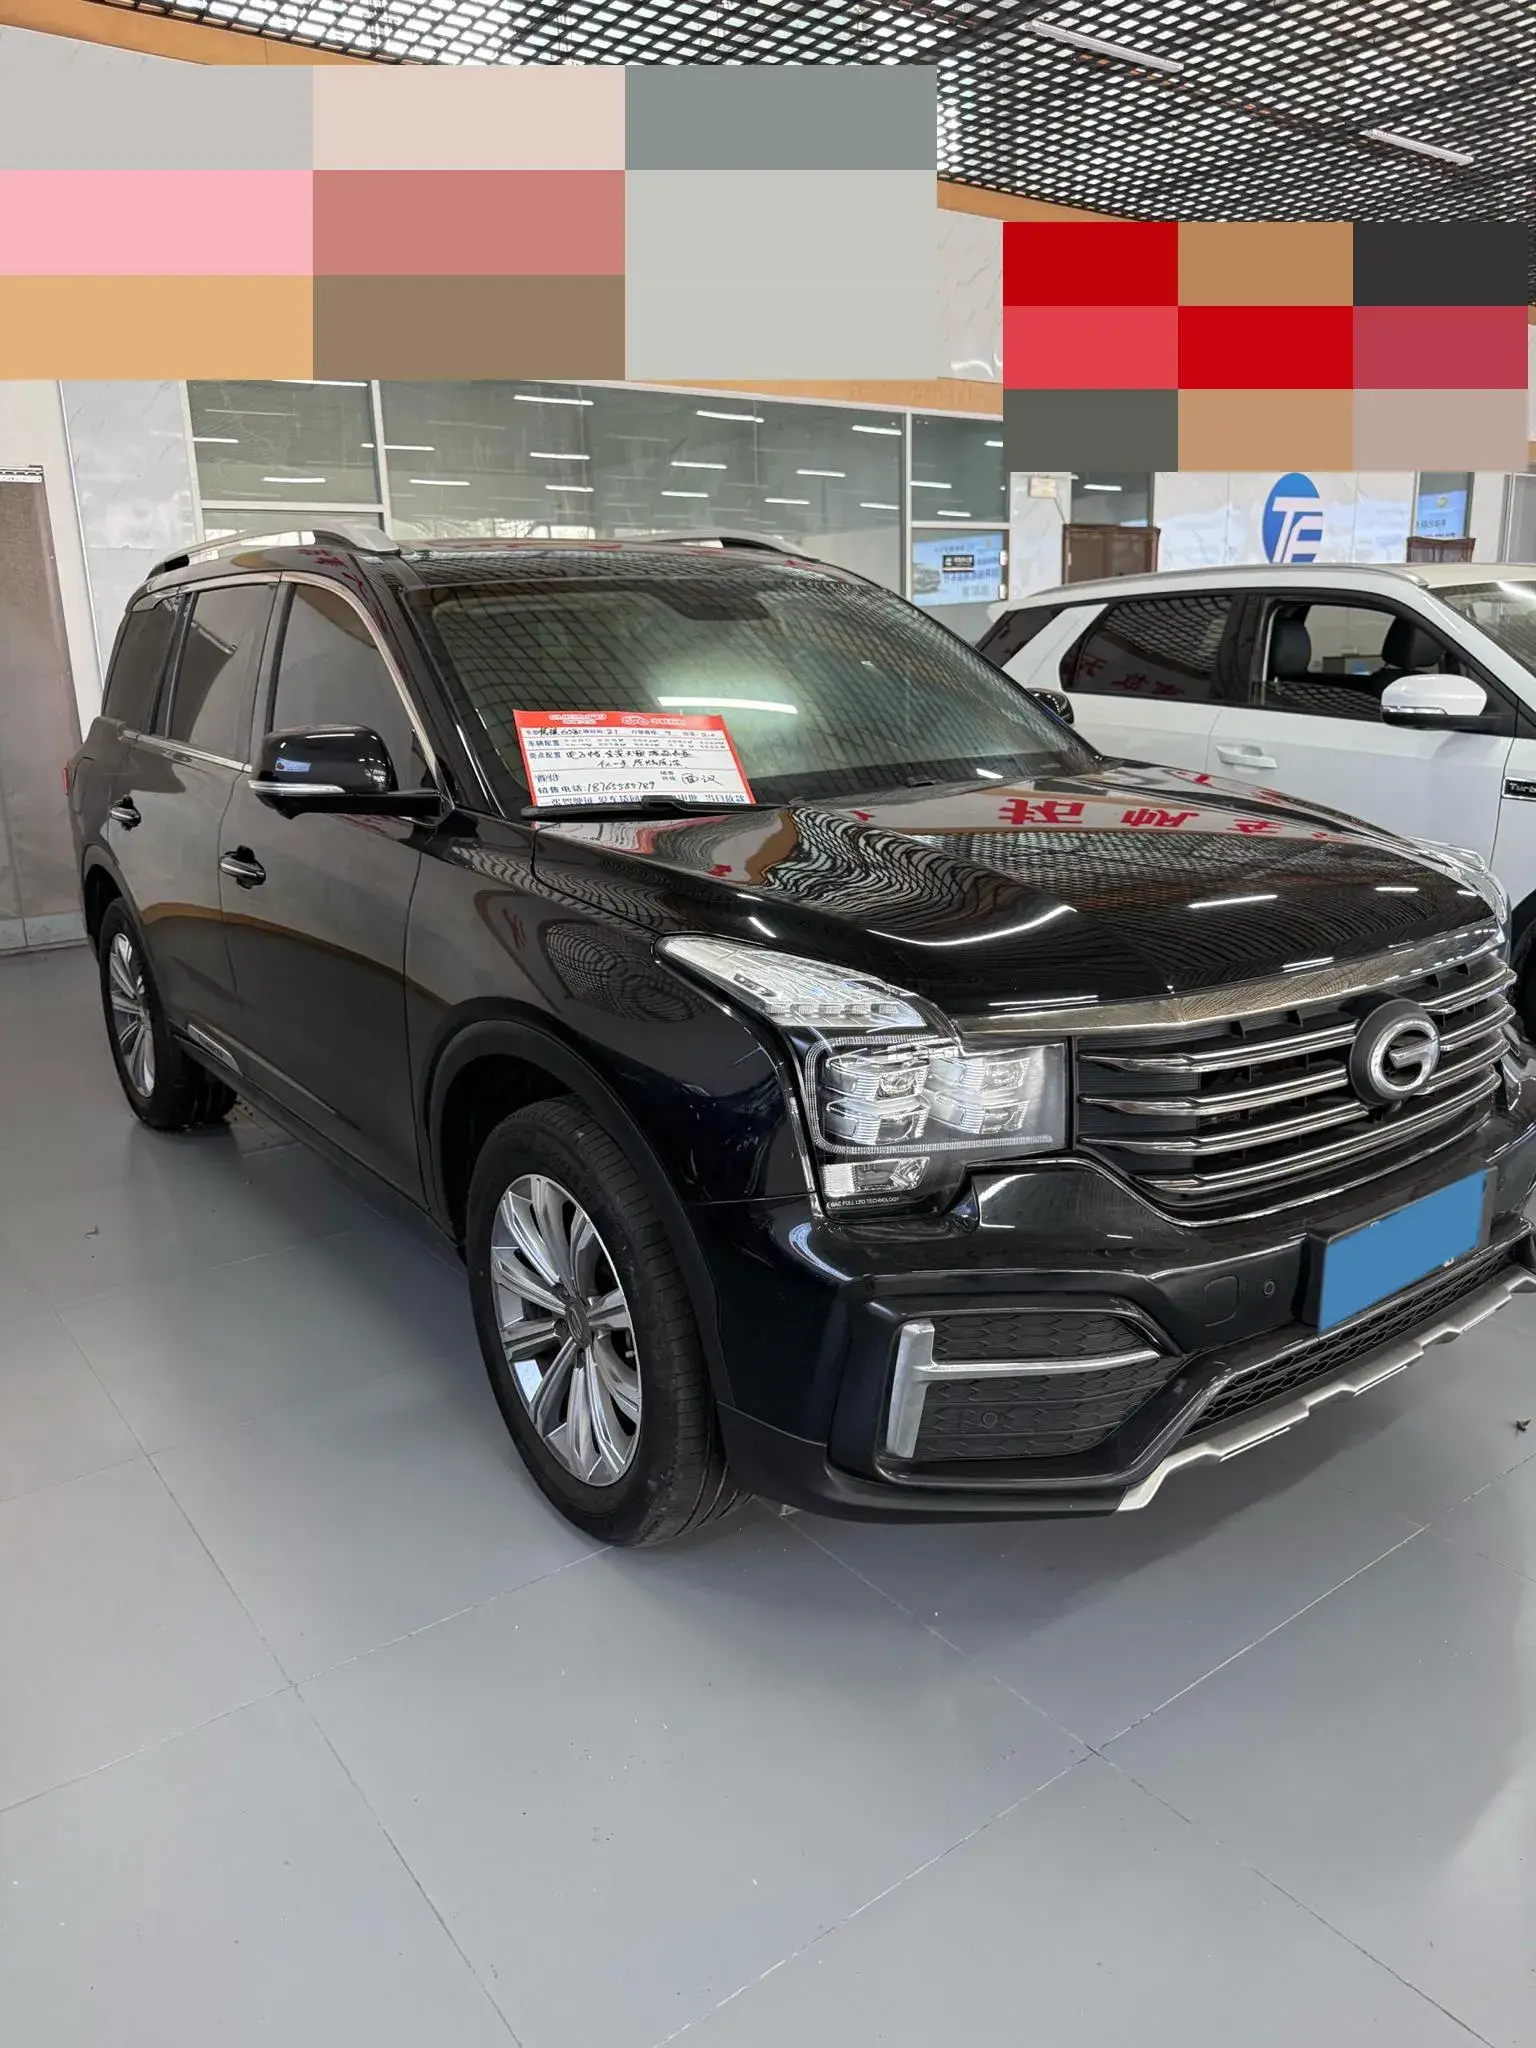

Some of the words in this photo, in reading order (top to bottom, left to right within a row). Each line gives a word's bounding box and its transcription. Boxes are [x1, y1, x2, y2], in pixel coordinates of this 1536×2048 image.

[528, 739, 560, 748] 车辆配置
[529, 751, 562, 759] 亮点配置
